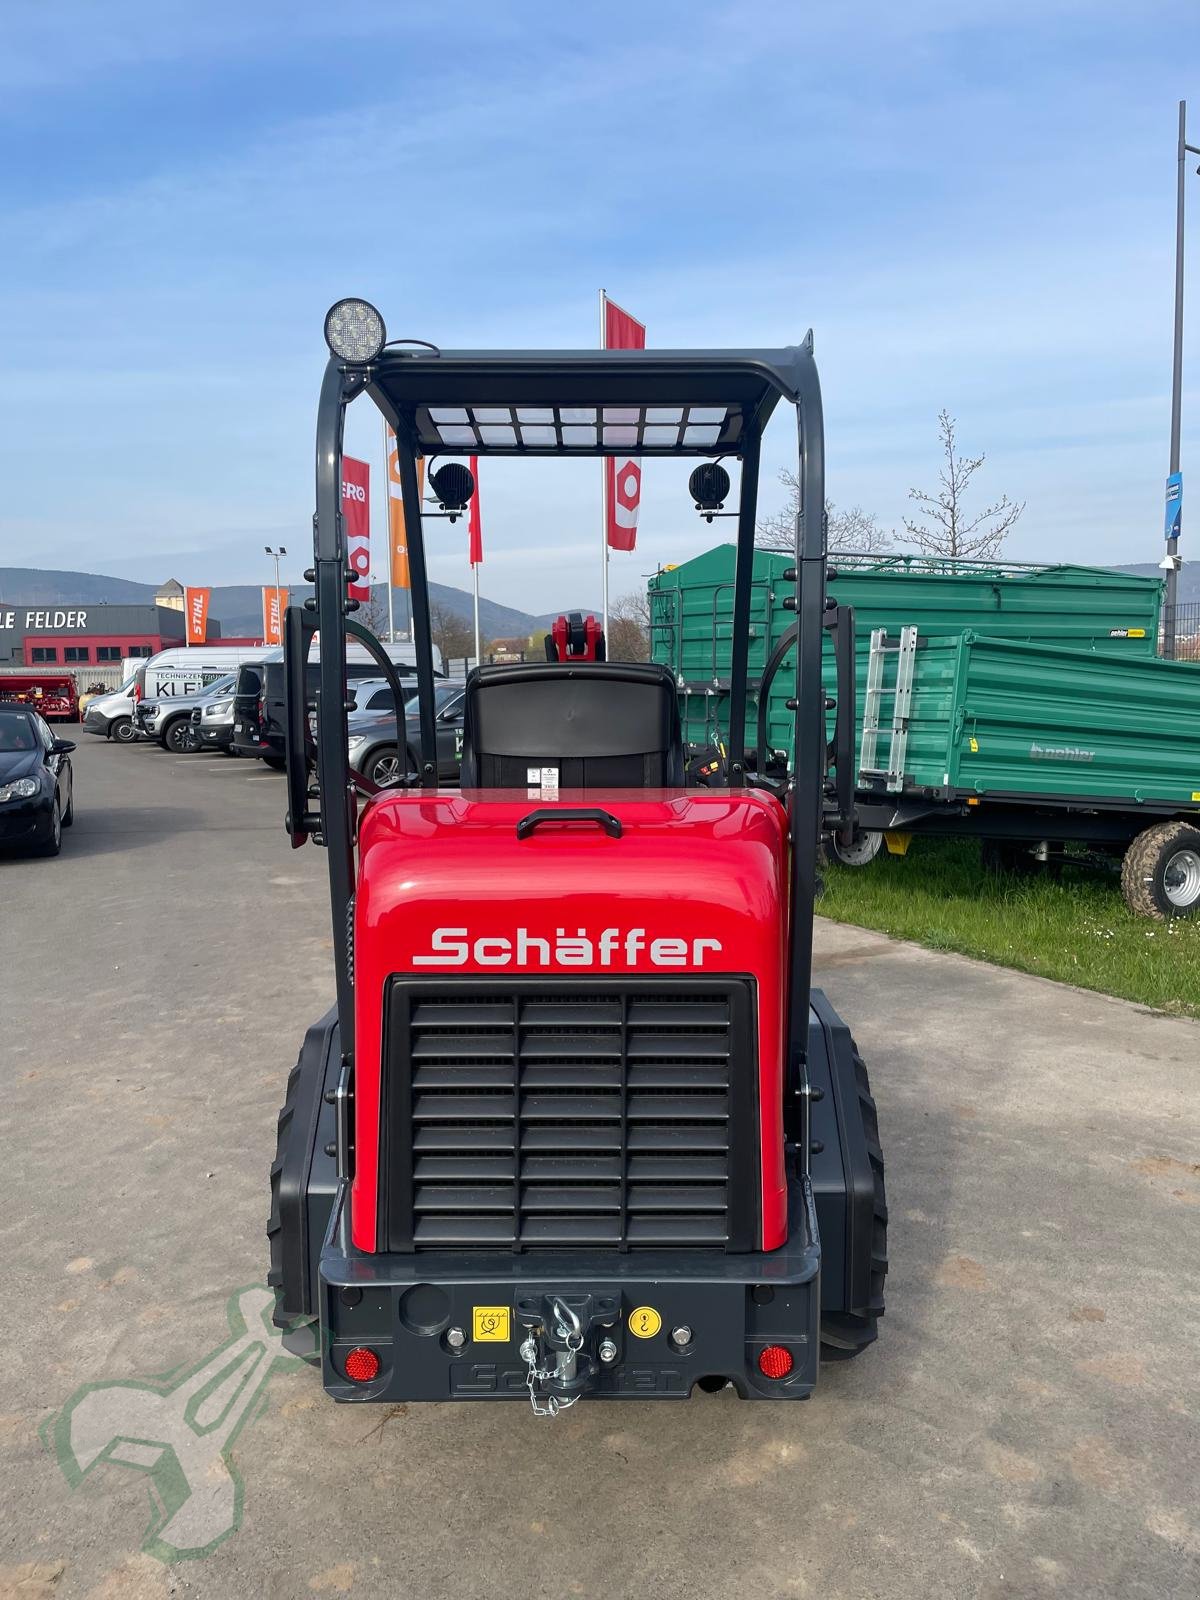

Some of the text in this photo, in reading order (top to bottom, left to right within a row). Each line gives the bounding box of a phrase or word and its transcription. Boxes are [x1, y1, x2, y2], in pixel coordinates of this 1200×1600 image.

[25, 611, 87, 629] FELDER
[192, 594, 204, 636] STIHL
[270, 597, 281, 636] STIHL
[412, 927, 723, 967] Schäffer
